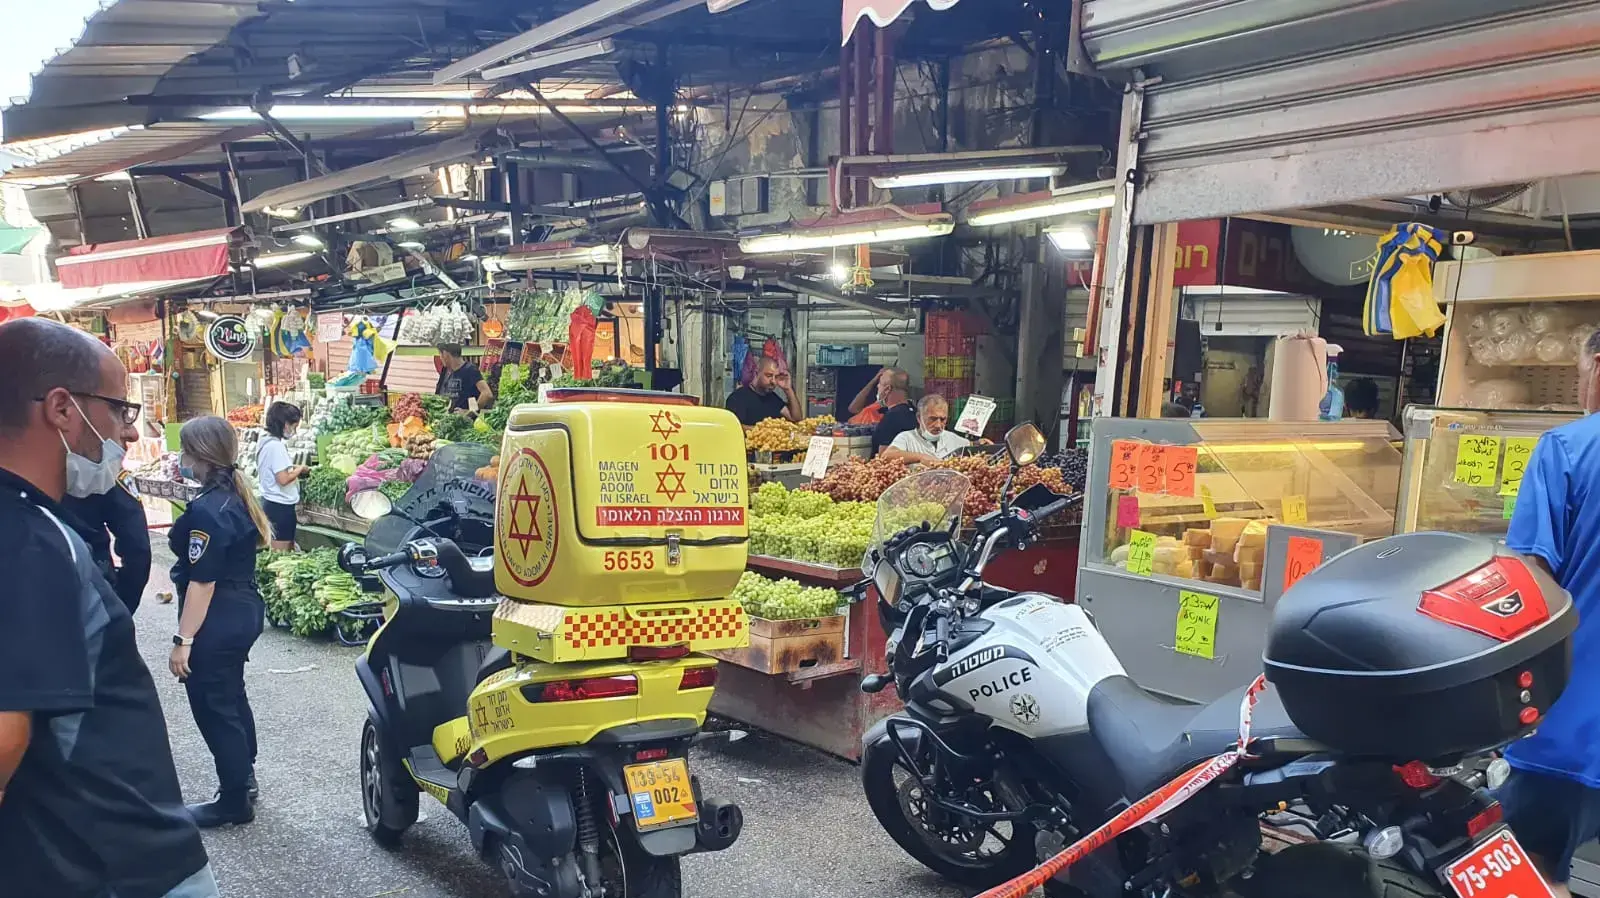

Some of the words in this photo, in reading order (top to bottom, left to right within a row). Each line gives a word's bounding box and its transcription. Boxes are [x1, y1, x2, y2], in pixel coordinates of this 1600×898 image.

[647, 443, 690, 461] 101
[599, 461, 639, 472] MAGEN
[695, 463, 715, 474] דוד
[719, 464, 738, 477] מגן
[1115, 463, 1129, 483] 3
[1170, 462, 1187, 482] 5
[599, 471, 634, 482] DAVID
[1143, 465, 1158, 485] 3
[600, 483, 635, 492] ADOM
[710, 478, 739, 490] אדום
[600, 494, 613, 504] IN
[616, 493, 651, 504] ISRAEL
[692, 489, 740, 505] בישראל
[601, 509, 651, 522] הלאומי
[656, 509, 702, 522] ההצלה
[707, 509, 741, 523] ארגון
[603, 550, 655, 571] 5653
[951, 645, 1005, 679] משטרה
[968, 667, 1033, 702] POLICE
[654, 786, 681, 804] 002
[1456, 843, 1521, 897] 75-503
